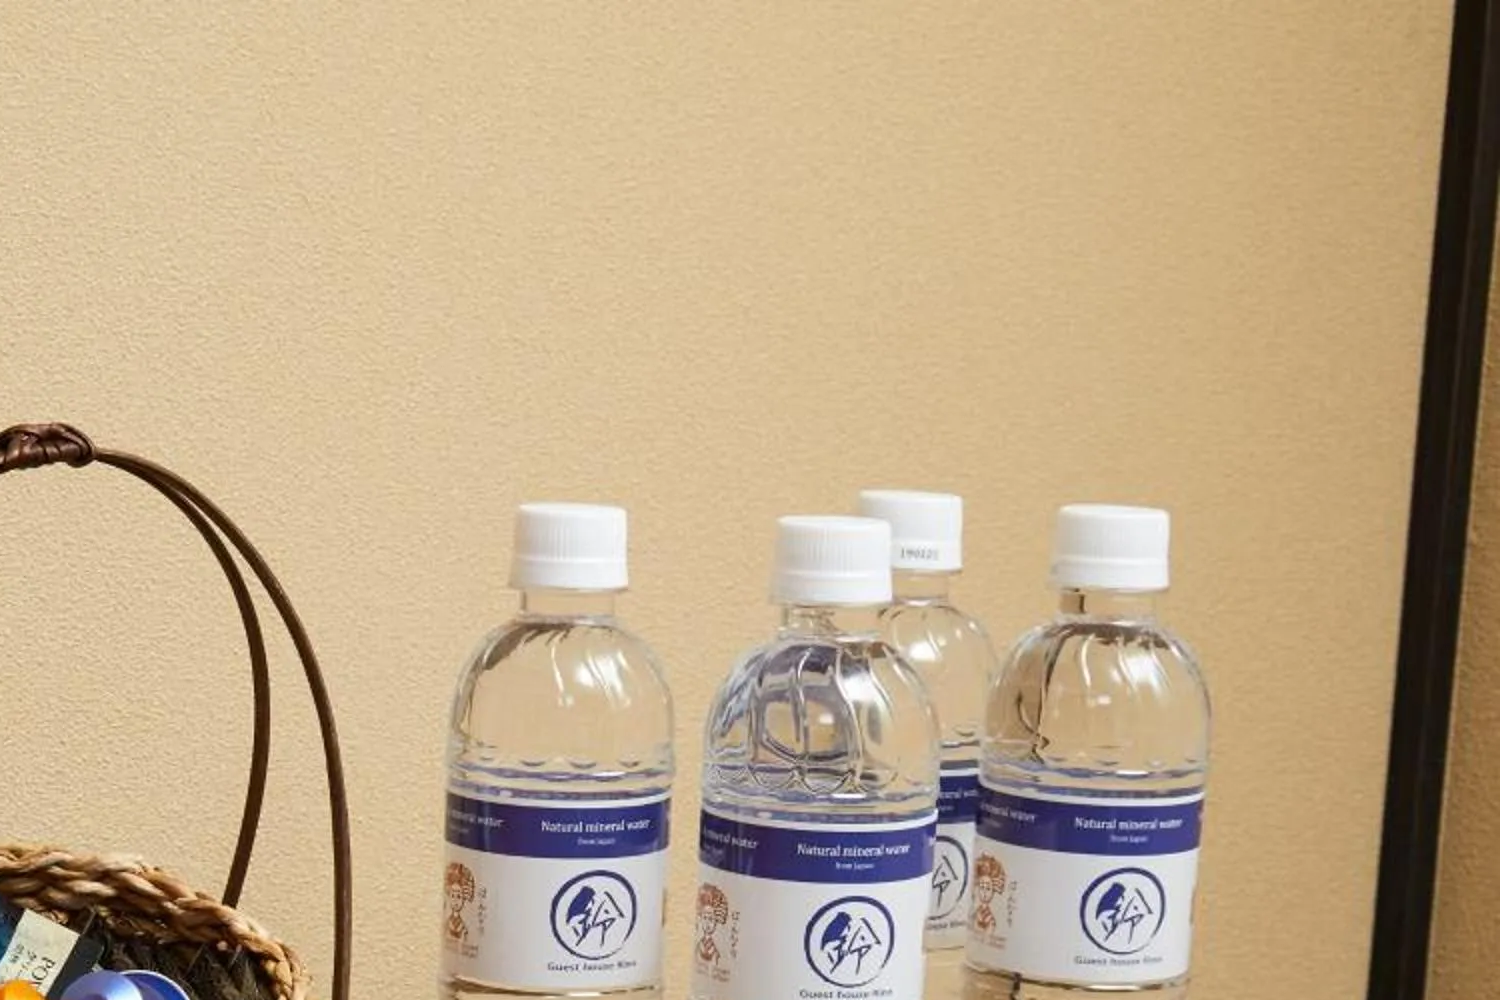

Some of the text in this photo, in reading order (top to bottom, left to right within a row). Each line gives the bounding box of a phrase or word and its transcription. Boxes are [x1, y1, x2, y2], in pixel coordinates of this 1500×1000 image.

[541, 818, 651, 834] Natural mineral water
[1074, 817, 1183, 830] Natural mineral water
[797, 843, 911, 857] Natural mineral water
[547, 961, 580, 972] Guest
[799, 988, 833, 999] Guest
